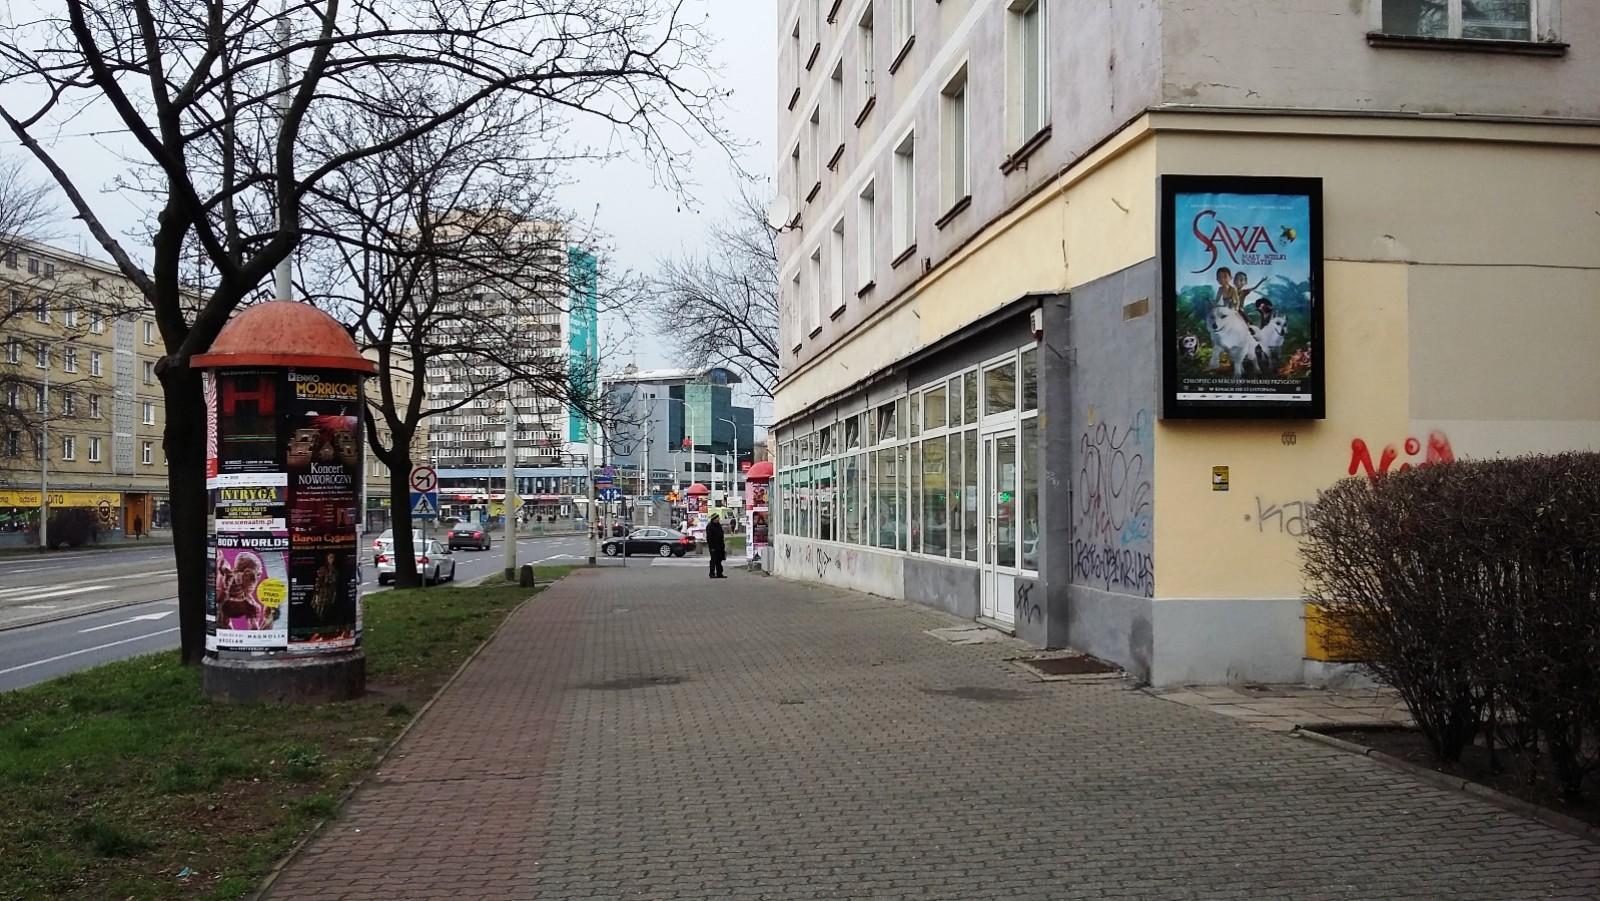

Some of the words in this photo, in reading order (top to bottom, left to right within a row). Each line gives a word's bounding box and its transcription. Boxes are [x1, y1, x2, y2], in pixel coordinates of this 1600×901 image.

[1190, 209, 1278, 274] SAWA
[296, 374, 320, 383] ENNIO
[296, 381, 359, 396] MORRICONE
[310, 462, 343, 474] Koncert
[298, 474, 353, 485] NOWOROCZNY
[221, 487, 277, 501] INTRYGA
[217, 538, 239, 548] BODY
[241, 538, 289, 547] WORLDS
[292, 533, 322, 542] Baron
